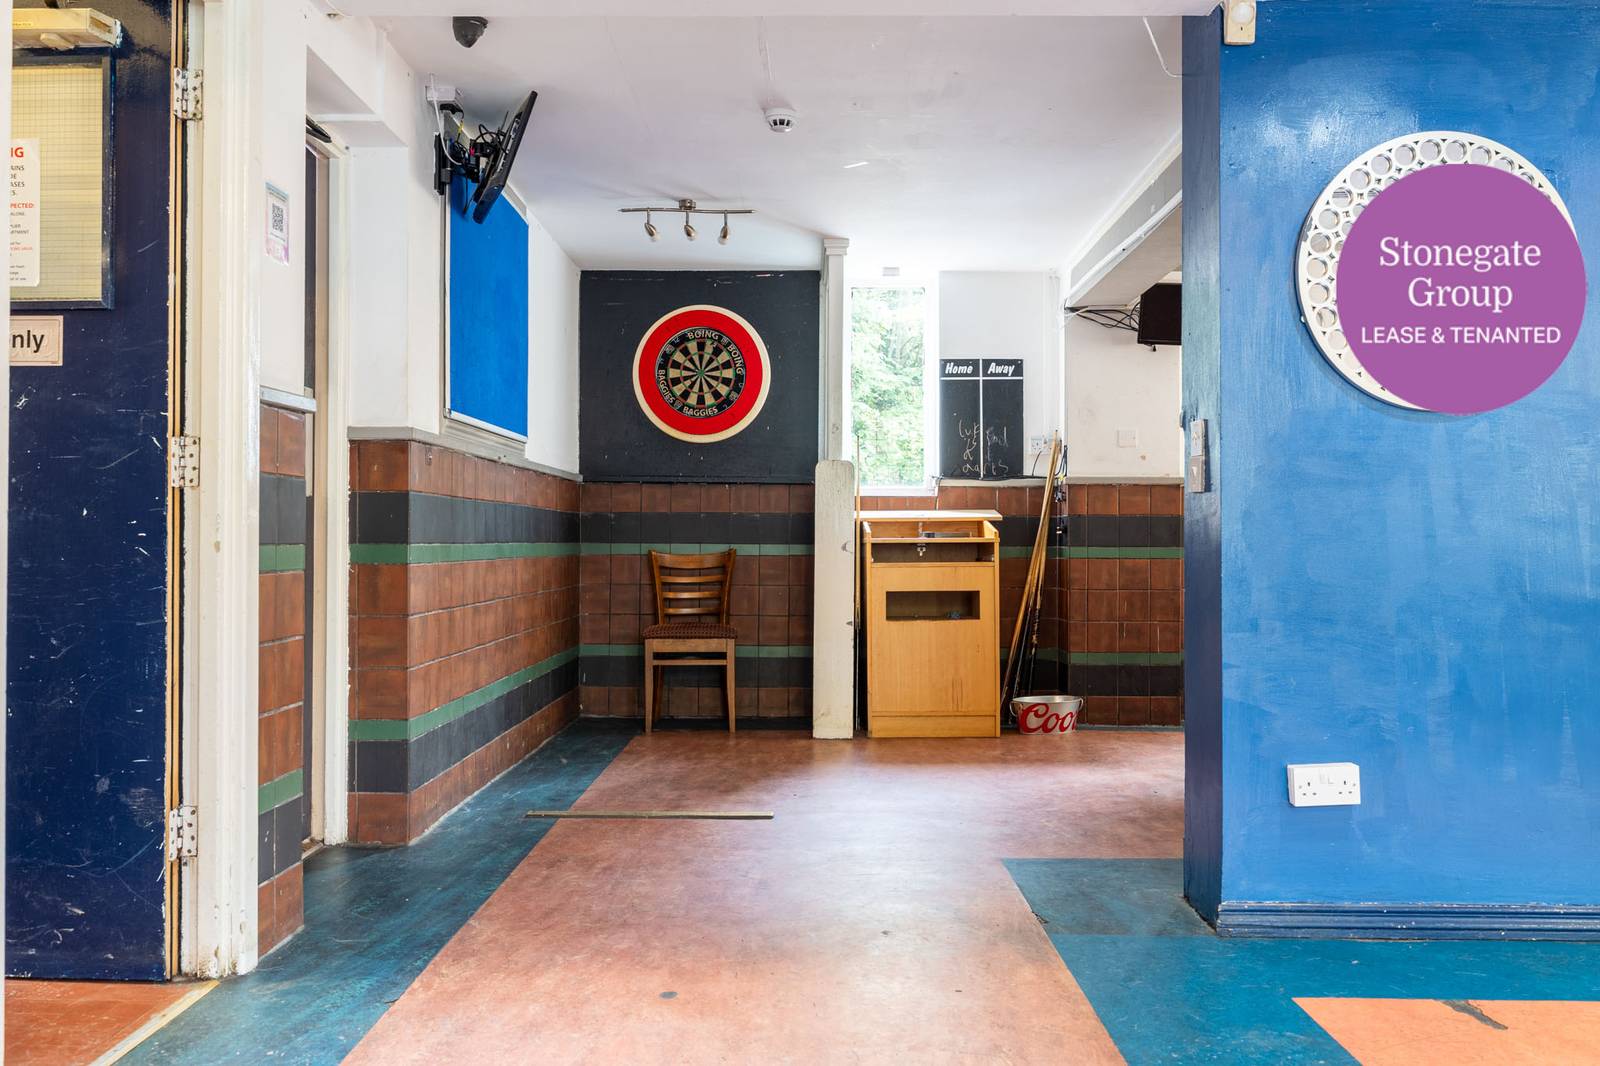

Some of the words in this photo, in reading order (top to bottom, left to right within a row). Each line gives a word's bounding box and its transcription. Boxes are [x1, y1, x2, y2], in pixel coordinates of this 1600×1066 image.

[687, 330, 720, 340] BOING
[727, 344, 744, 375] BOING
[945, 362, 974, 374] Home
[987, 362, 1015, 376] Away
[658, 369, 676, 403] BAGGIES
[683, 406, 719, 416] BAGGIES
